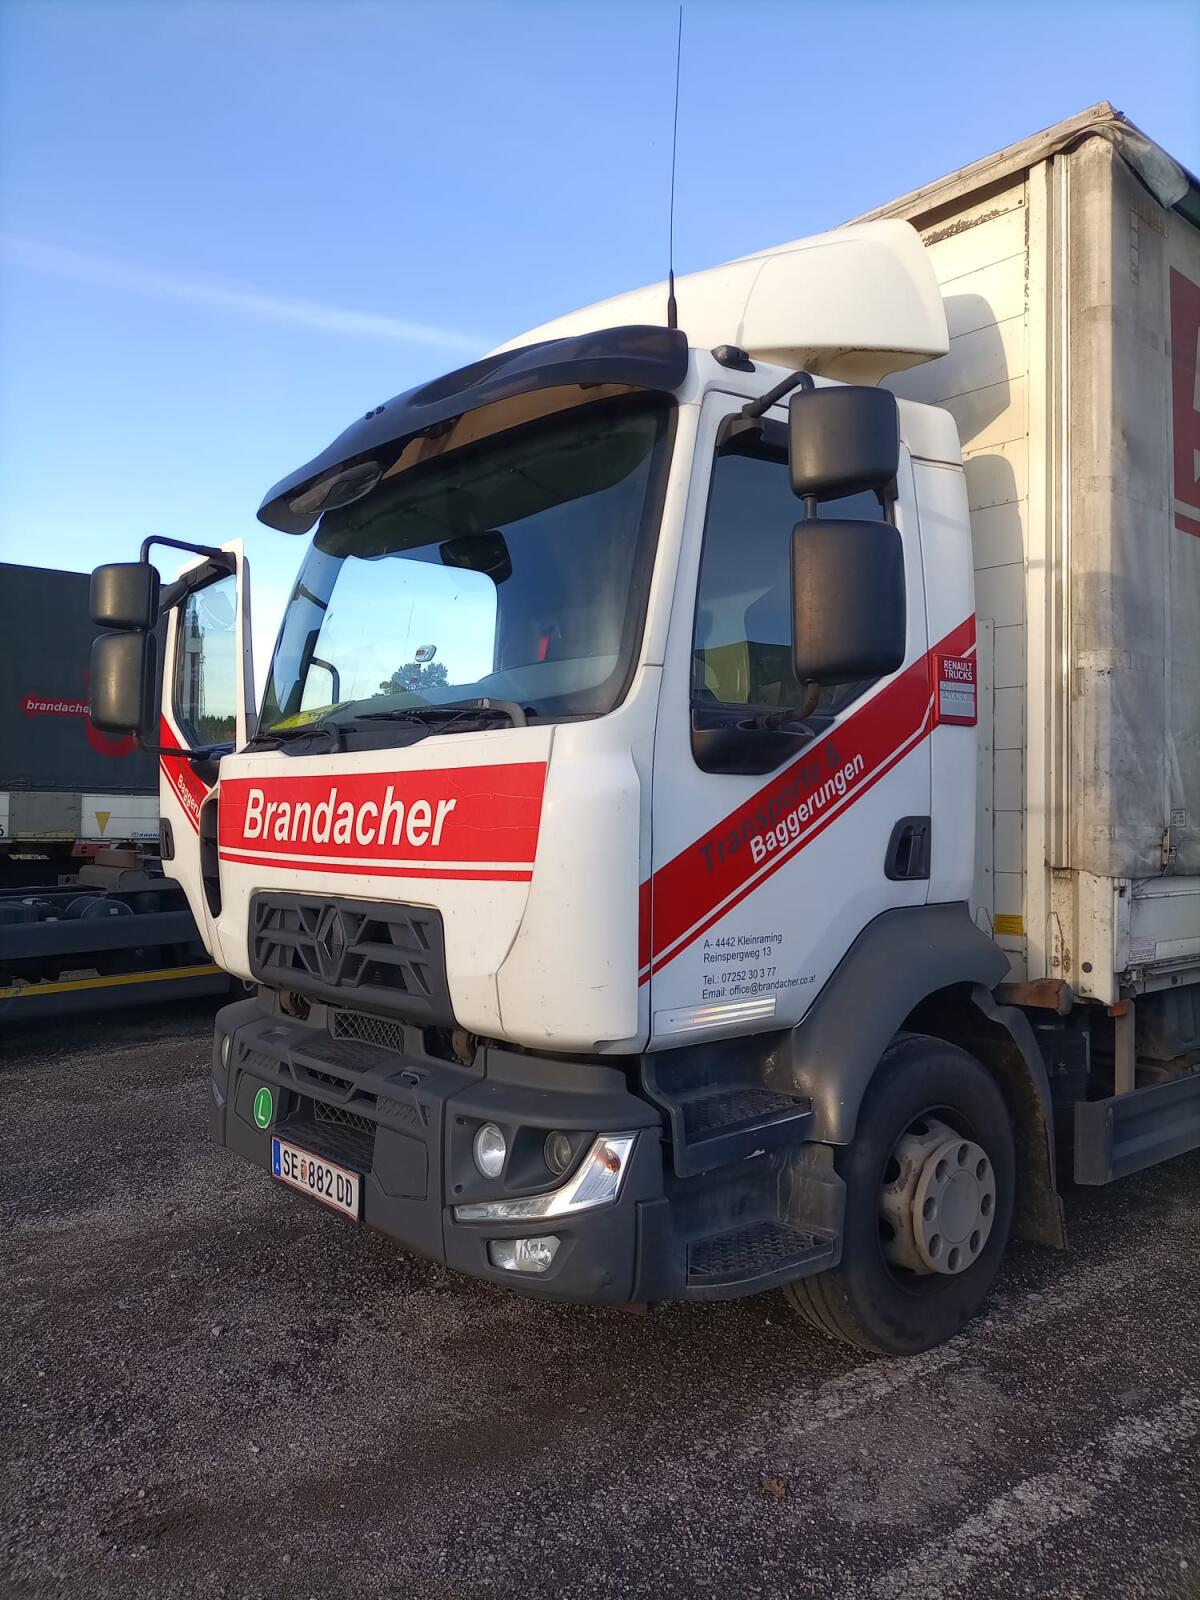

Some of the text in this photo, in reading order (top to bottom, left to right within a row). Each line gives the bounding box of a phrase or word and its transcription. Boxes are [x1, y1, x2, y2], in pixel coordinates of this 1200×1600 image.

[943, 659, 973, 672] RENAULT
[944, 669, 973, 681] TRUCKS
[26, 700, 90, 714] brandache
[243, 785, 457, 847] Brandacher
[700, 761, 821, 873] Transporte
[750, 753, 866, 864] Baggerungen
[715, 936, 736, 947] 4442
[737, 932, 783, 946] Kleinraming
[703, 946, 772, 963] Reinspergweg 13
[702, 966, 777, 985] Tel.: 07252 30 3 77
[702, 974, 816, 999] Email: office@brandacher.co.at
[258, 1095, 265, 1121] L
[283, 1149, 353, 1208] SE 882 DD
